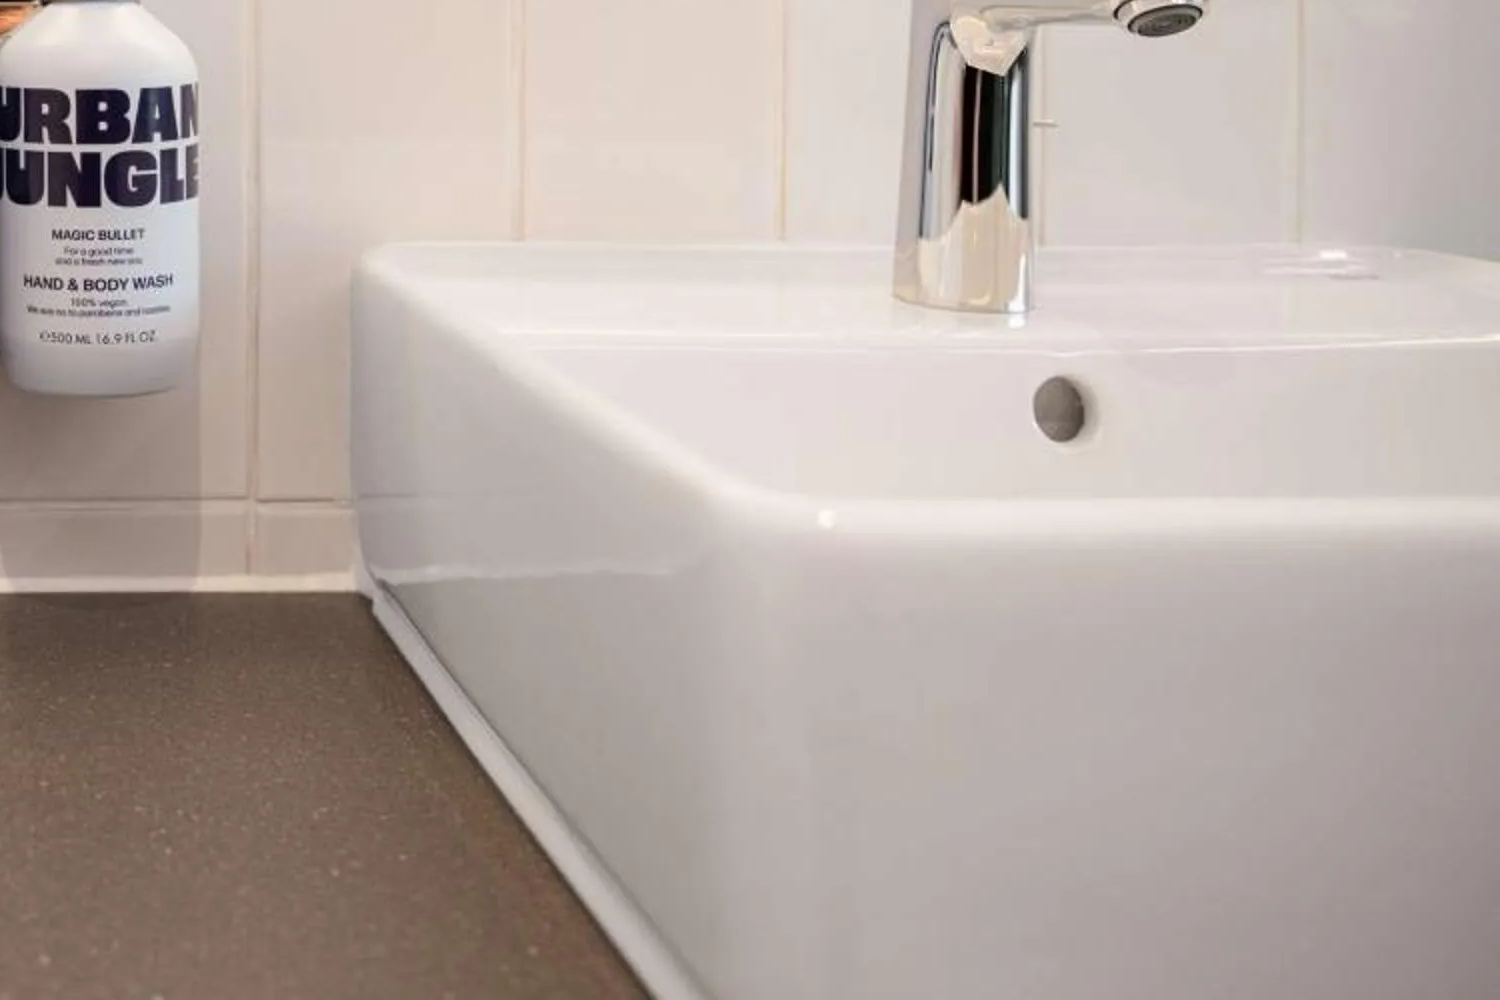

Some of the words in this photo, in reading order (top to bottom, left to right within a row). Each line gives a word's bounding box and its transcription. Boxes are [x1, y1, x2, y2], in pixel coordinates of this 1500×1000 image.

[51, 229, 95, 241] MAGIC
[98, 228, 145, 241] BULLET
[63, 247, 78, 256] For
[89, 247, 112, 258] good
[23, 274, 64, 290] HAND
[67, 278, 79, 292] &
[83, 277, 129, 292] BODY
[132, 273, 174, 290] WASH
[71, 297, 97, 307] 100%
[75, 333, 91, 345] ML
[96, 331, 124, 345] 16.9
